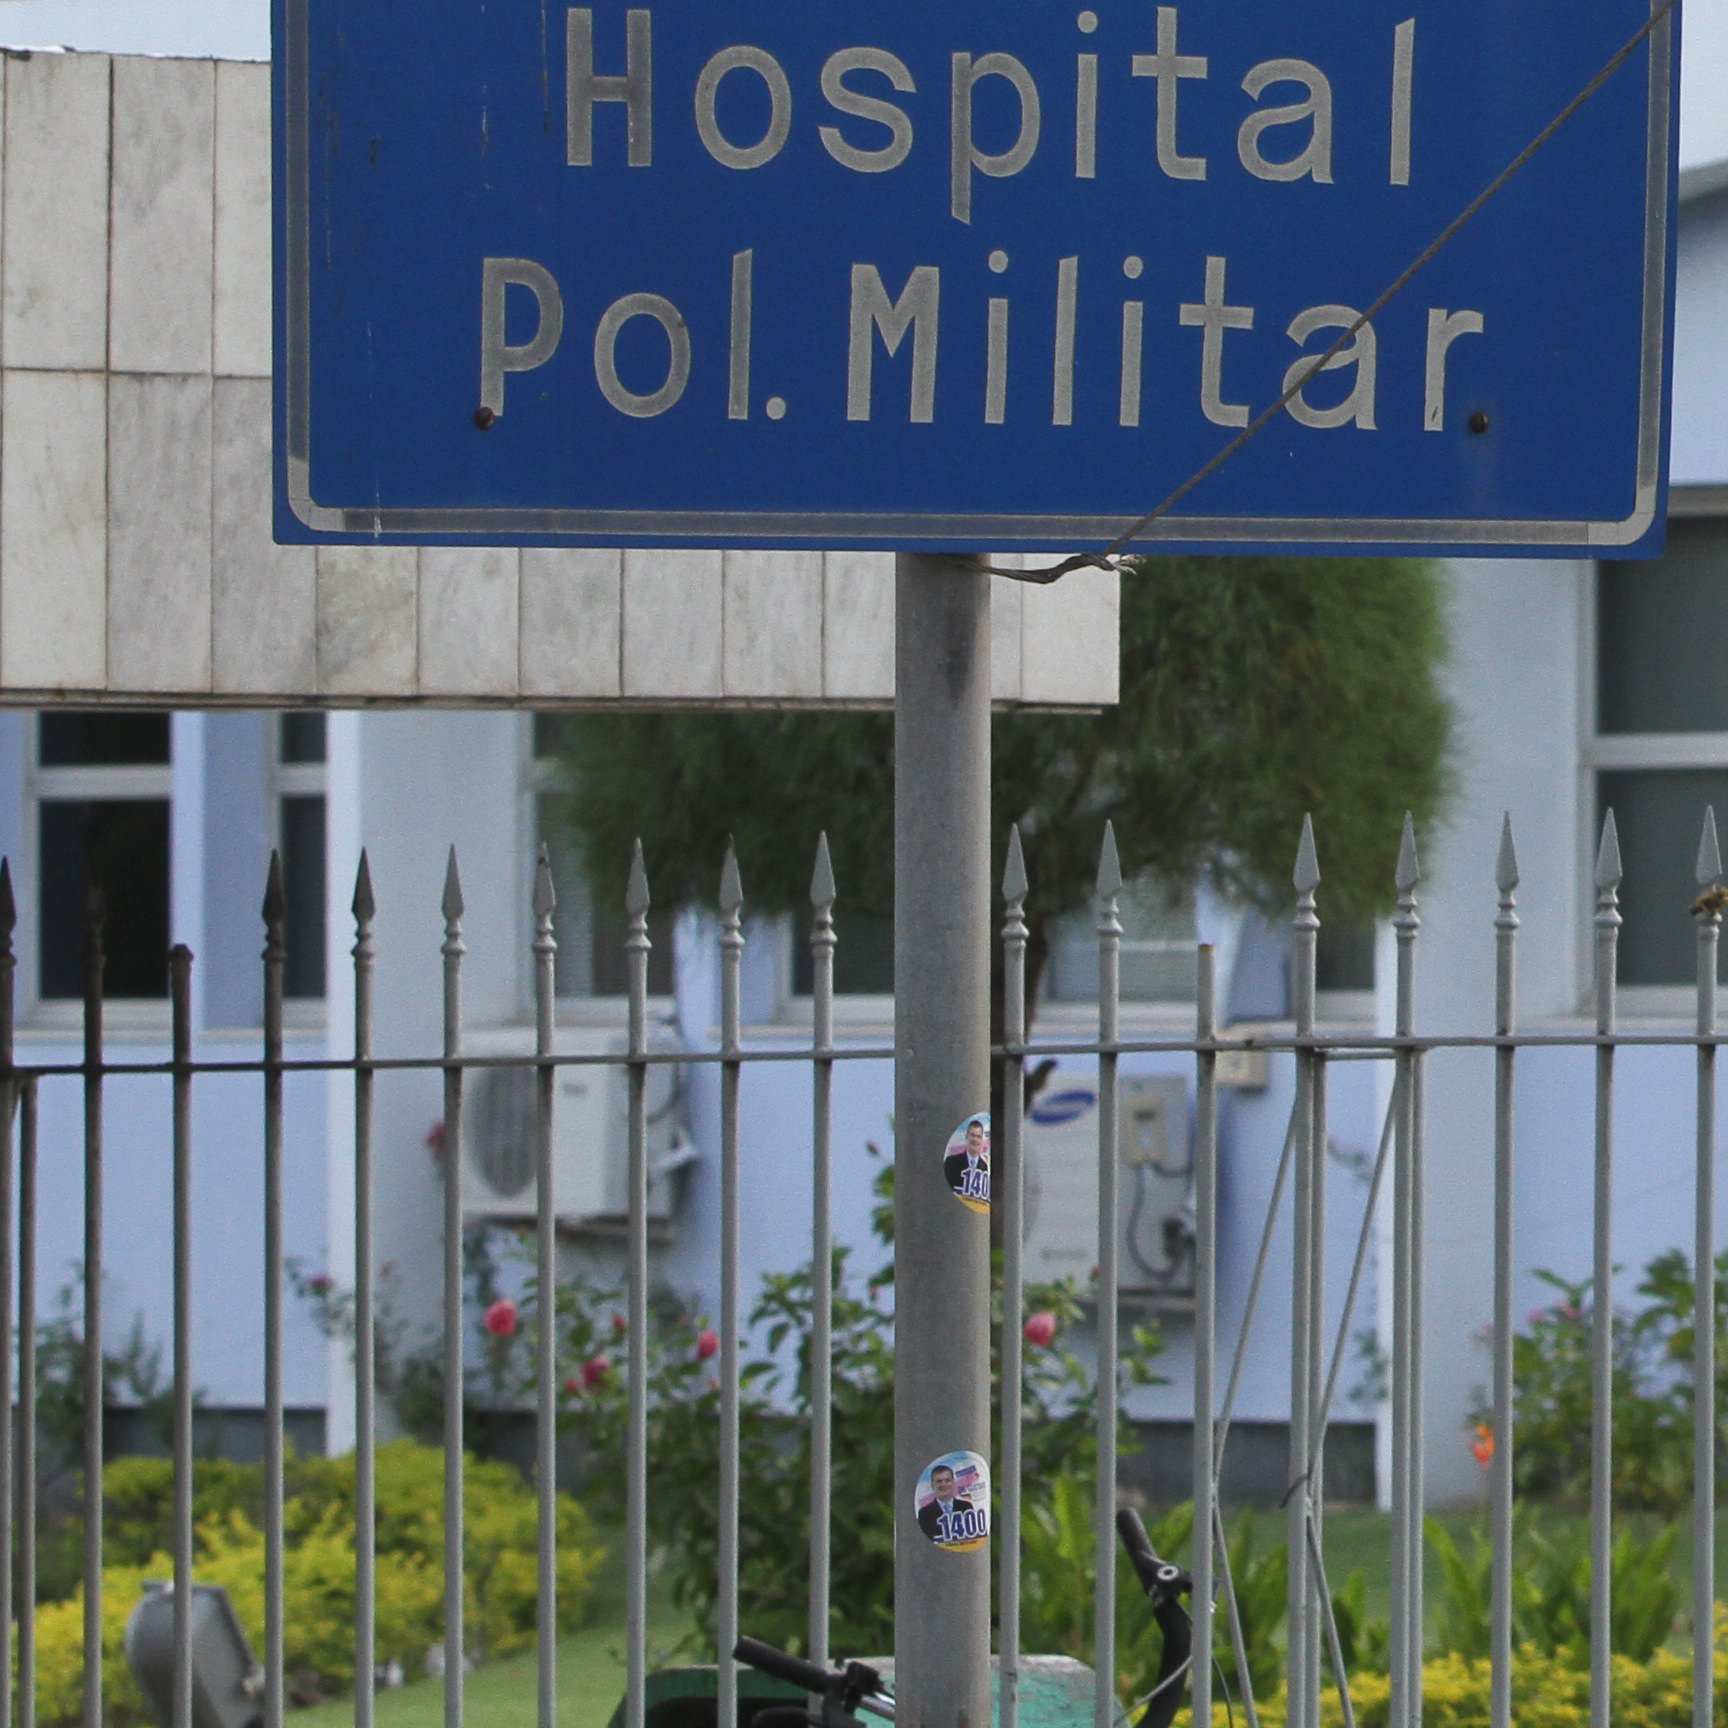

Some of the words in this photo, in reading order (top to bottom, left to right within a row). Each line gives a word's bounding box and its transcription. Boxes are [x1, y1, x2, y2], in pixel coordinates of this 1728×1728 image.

[566, 6, 1415, 225] Hospital
[478, 247, 787, 420] Pol.
[846, 248, 1484, 432] Militar
[937, 1508, 987, 1541] 1400
